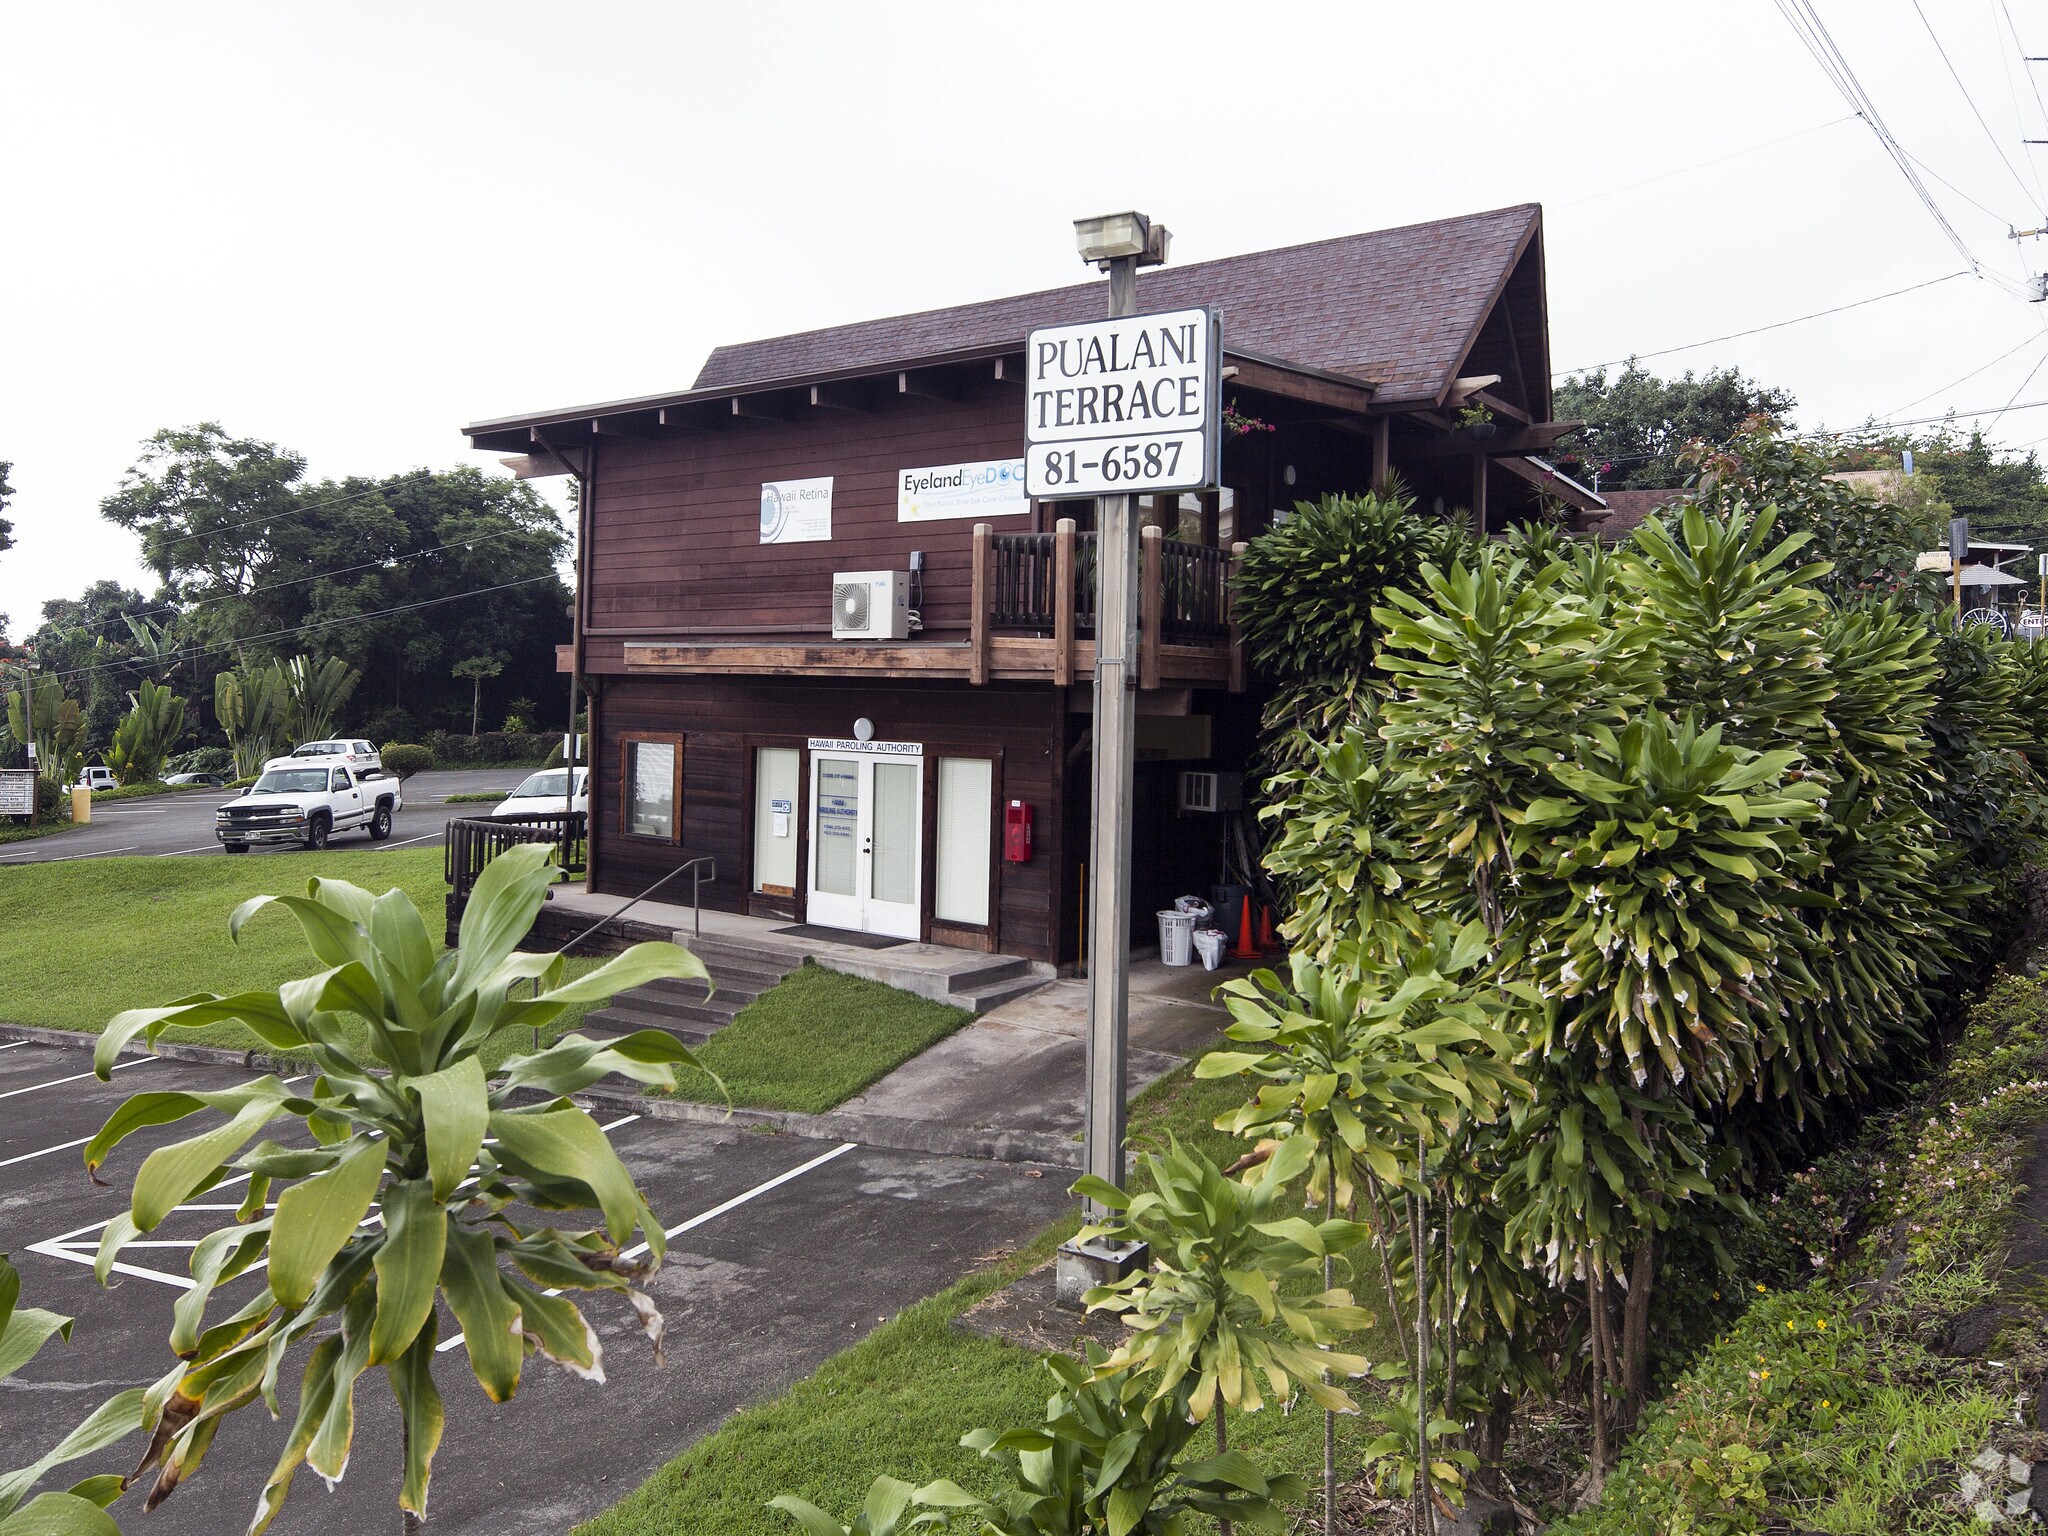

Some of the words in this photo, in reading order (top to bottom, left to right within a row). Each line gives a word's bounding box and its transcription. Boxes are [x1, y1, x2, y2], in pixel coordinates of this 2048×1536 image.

[1037, 323, 1198, 380] PUALANI
[1033, 376, 1200, 428] TERRACE
[1044, 441, 1183, 486] 81-6587
[766, 490, 797, 503] Hawaii
[799, 488, 829, 501] Retina
[809, 740, 834, 749] HAWAII
[836, 741, 873, 751] PAROLING
[876, 743, 921, 753] AUTHORITY
